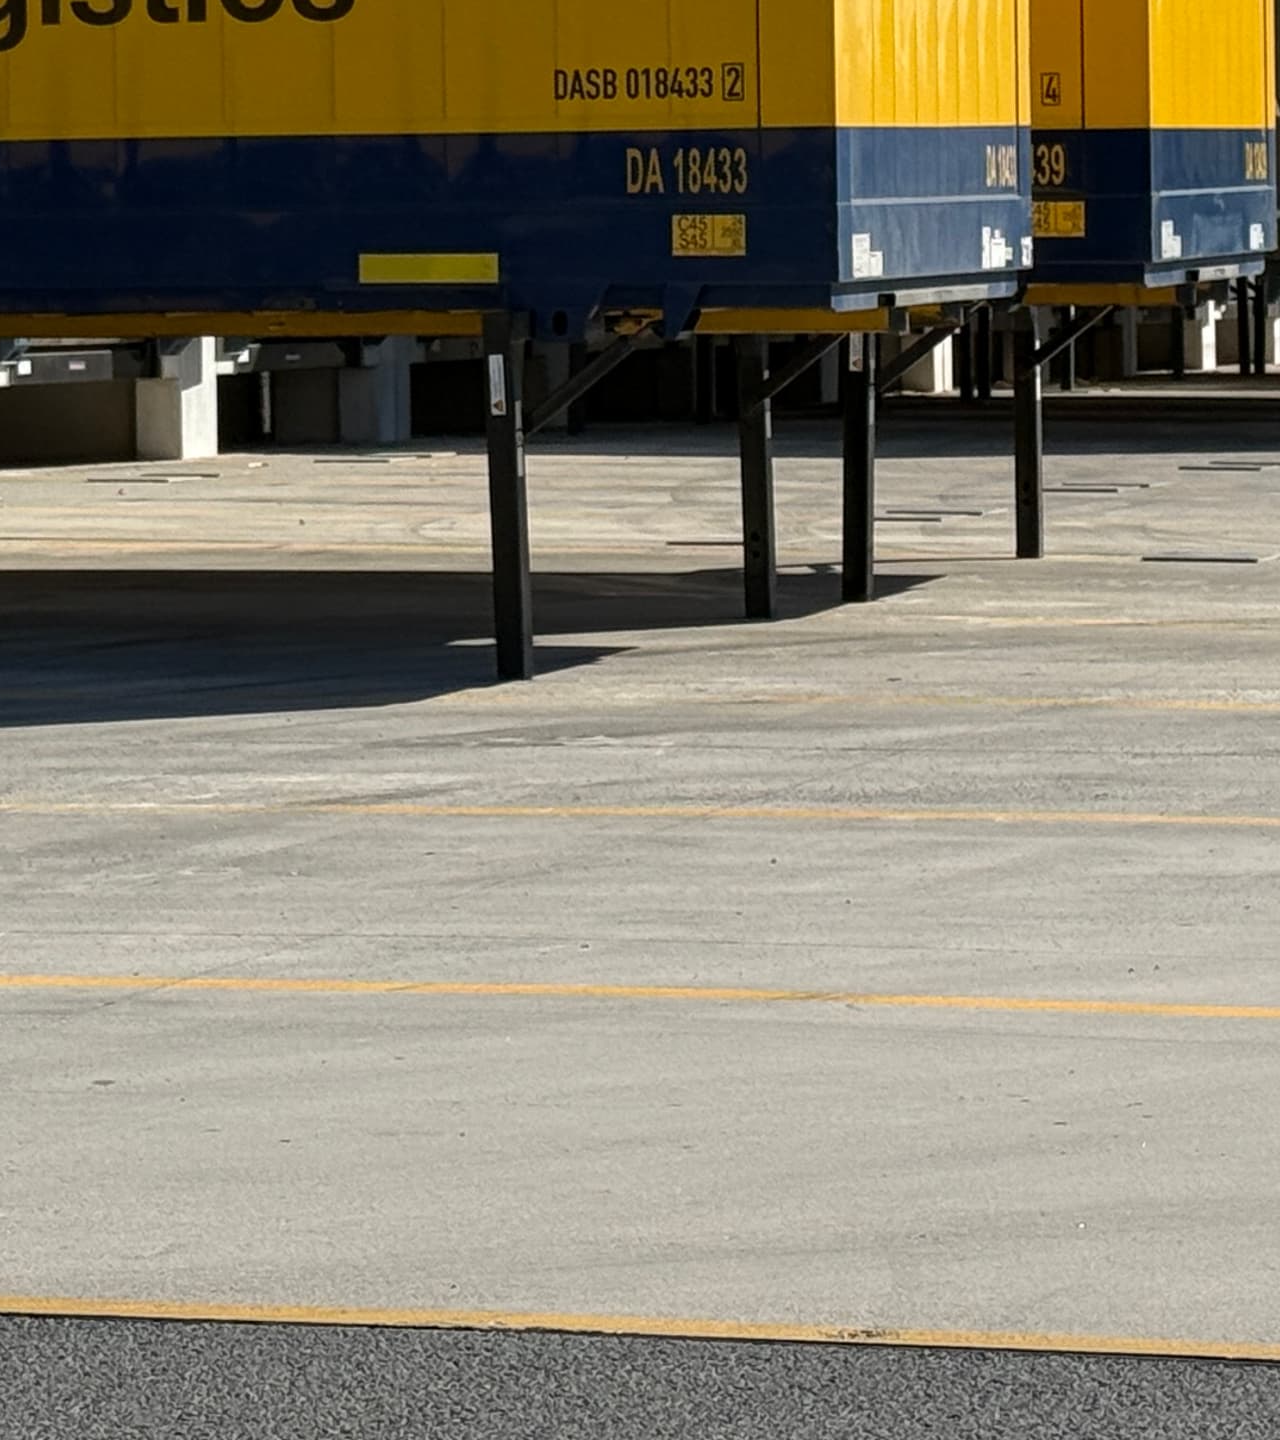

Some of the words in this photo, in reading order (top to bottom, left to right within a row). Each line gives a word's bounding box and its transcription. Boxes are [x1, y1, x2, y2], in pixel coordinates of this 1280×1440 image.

[554, 68, 617, 100] DASB
[626, 66, 714, 100] 018433
[724, 65, 742, 99] 2
[1043, 75, 1060, 104] 4
[625, 146, 665, 194] DA
[673, 146, 748, 194] 18433
[1031, 143, 1065, 185] 39
[677, 216, 708, 231] C45
[678, 231, 708, 248] S45
